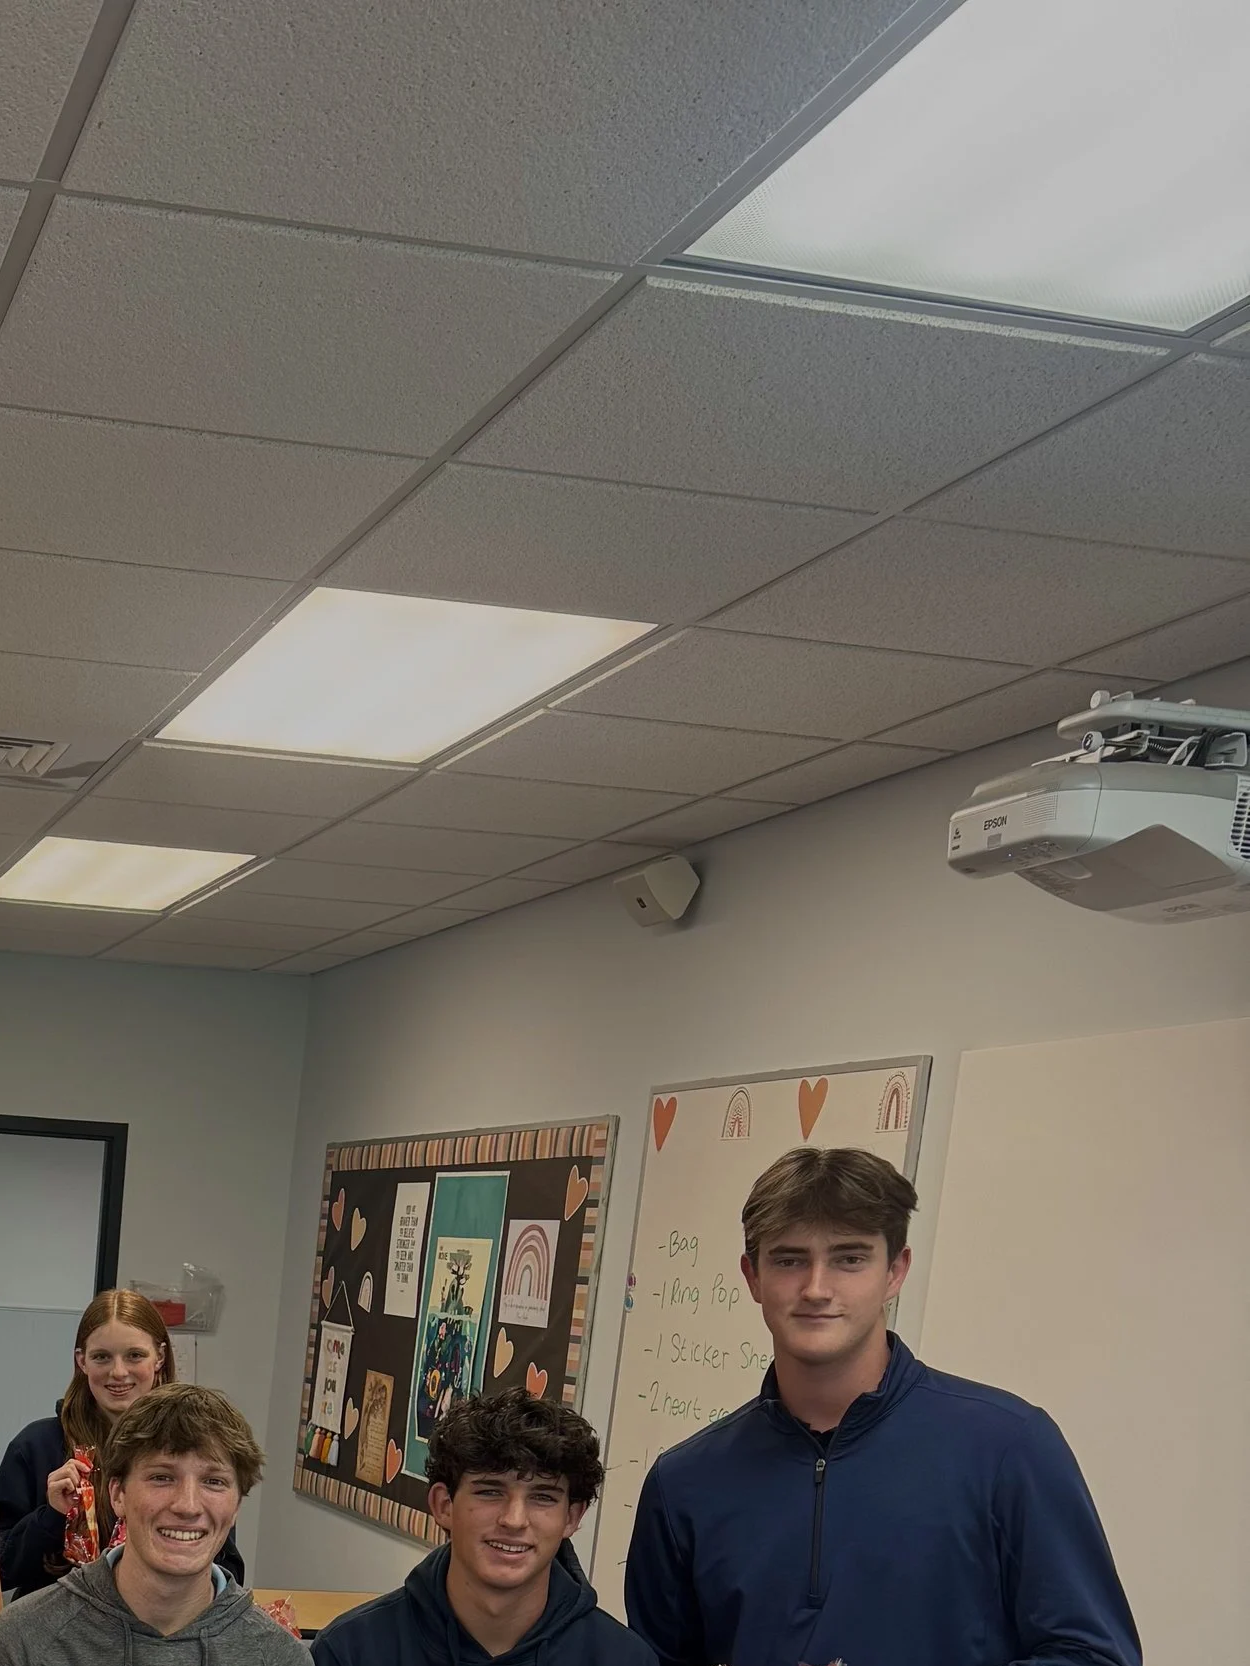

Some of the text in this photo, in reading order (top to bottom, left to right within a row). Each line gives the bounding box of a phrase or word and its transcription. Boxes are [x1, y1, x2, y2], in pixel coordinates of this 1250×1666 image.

[983, 815, 1008, 831] EPSON
[670, 1277, 700, 1315] Ring
[711, 1272, 740, 1312] Pop
[670, 1332, 731, 1371] Sticker
[740, 1341, 775, 1370] She
[662, 1391, 702, 1421] heart
